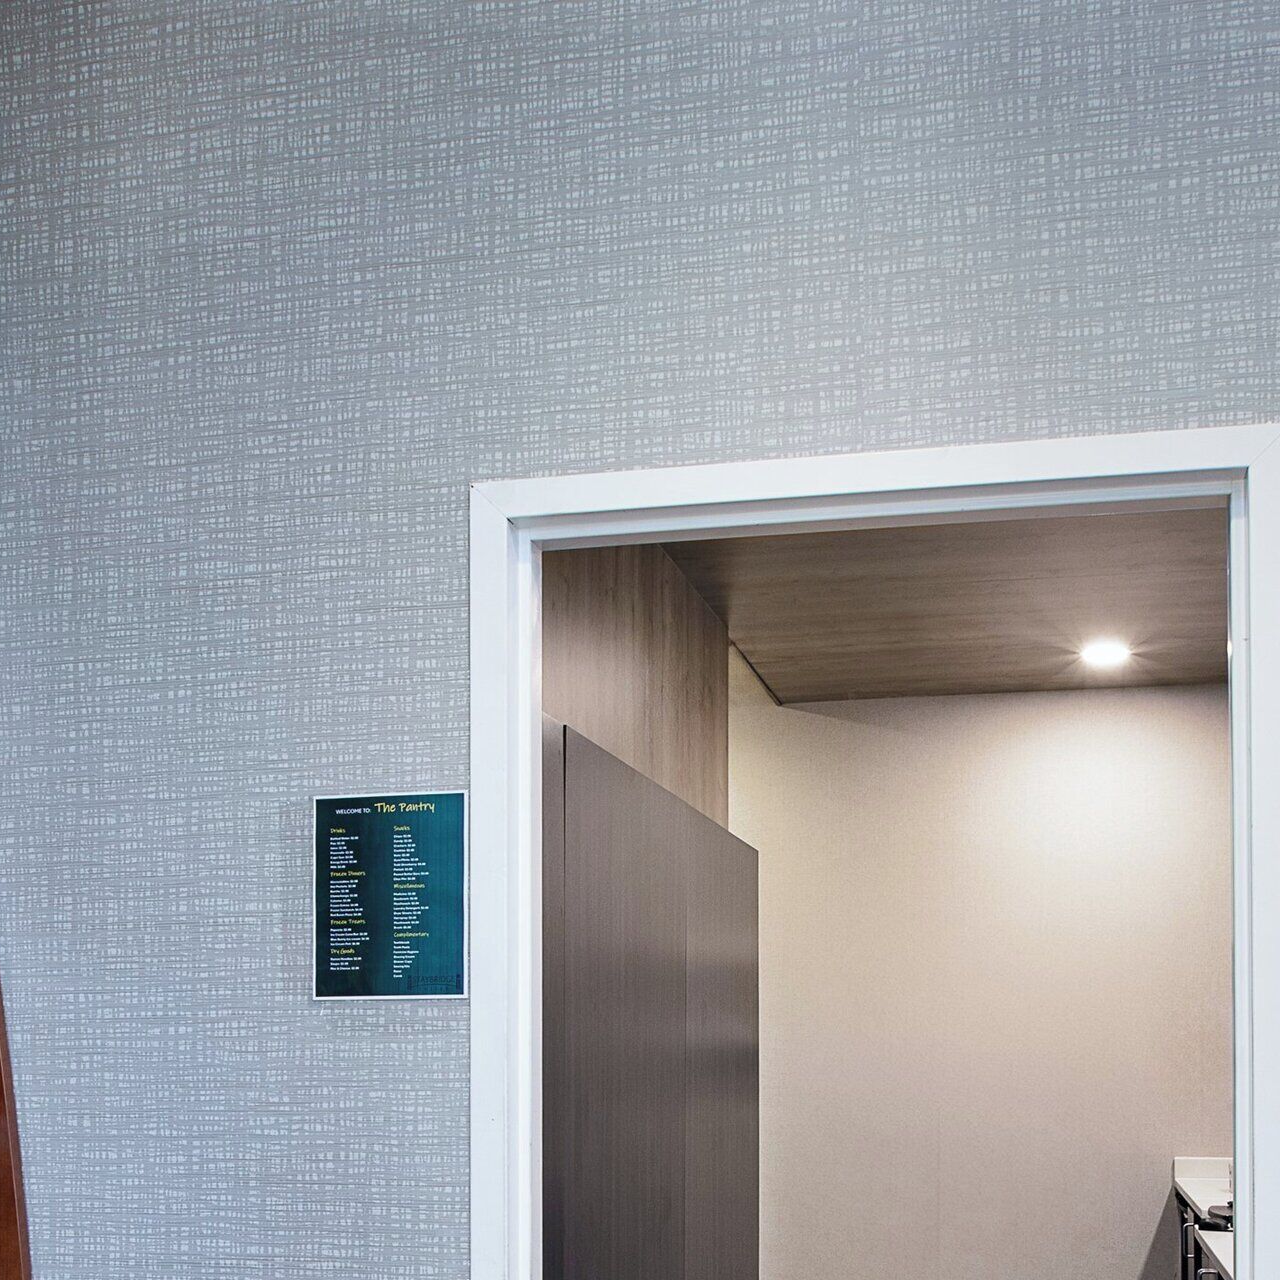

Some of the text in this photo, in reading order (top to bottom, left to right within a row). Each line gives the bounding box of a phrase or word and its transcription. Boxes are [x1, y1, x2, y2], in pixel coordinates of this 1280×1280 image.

[335, 807, 362, 815] WELCOME
[374, 801, 396, 814] The
[398, 801, 435, 815] Pantry
